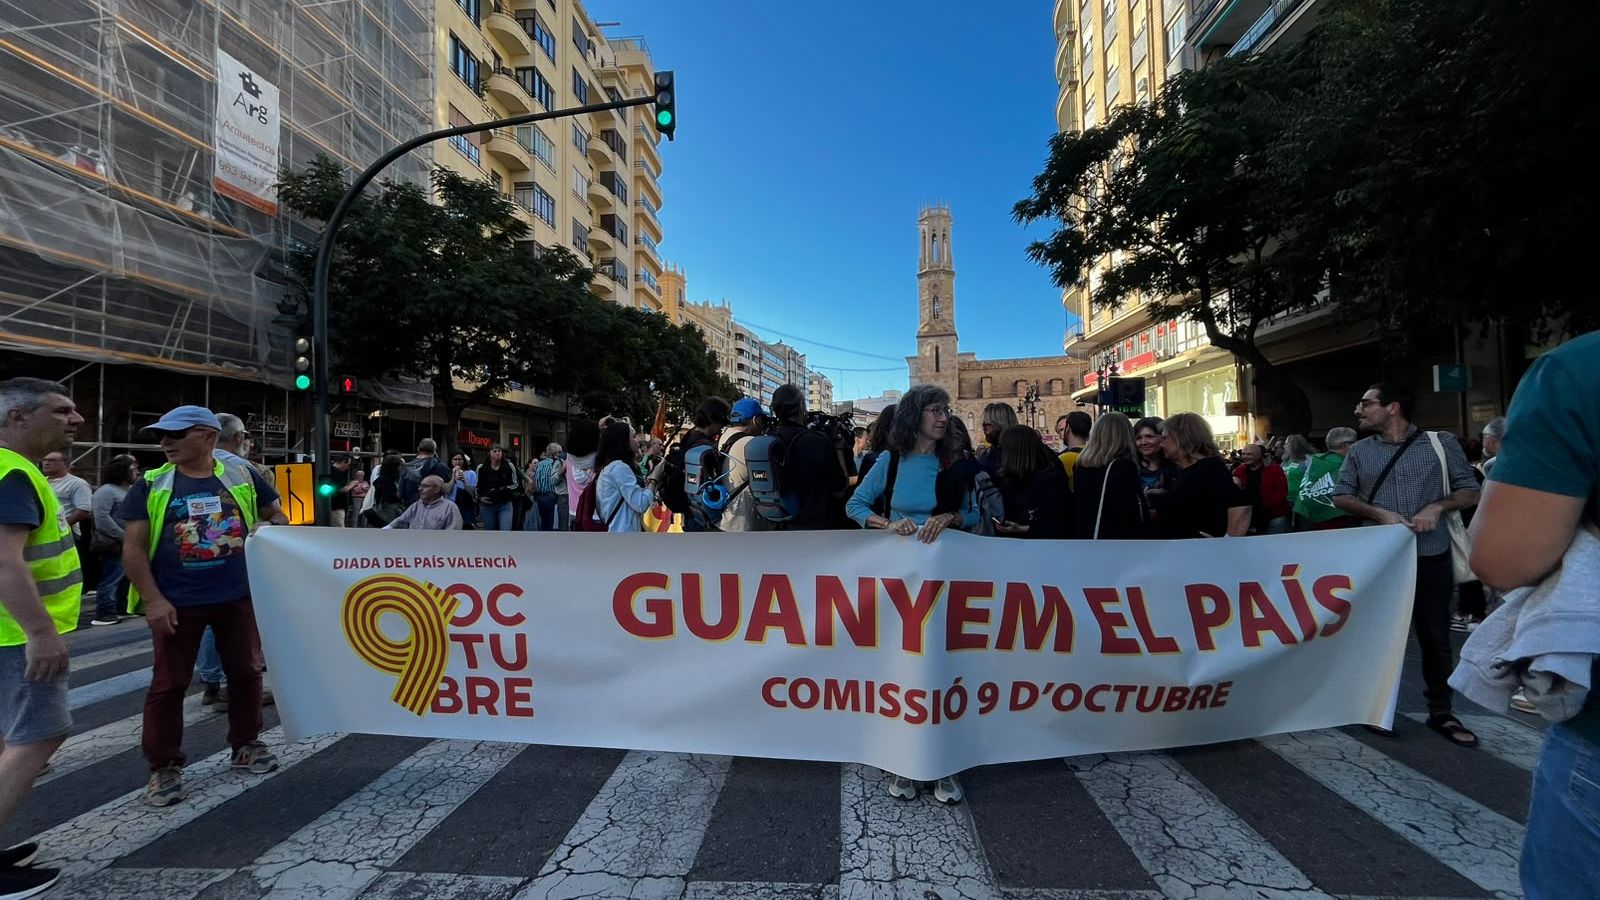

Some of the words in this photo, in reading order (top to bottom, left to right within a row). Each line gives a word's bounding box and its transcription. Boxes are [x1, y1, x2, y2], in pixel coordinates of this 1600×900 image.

[233, 92, 267, 124] Arg
[223, 120, 276, 156] Arquitectos
[333, 557, 381, 569] DIADA
[384, 557, 411, 568] DEL
[414, 555, 444, 568] PAÍS
[447, 555, 518, 568] VALENCIÀ
[612, 571, 1075, 656] GUANYEM
[1082, 586, 1182, 656] EL
[1184, 563, 1353, 652] PAÍS
[761, 676, 968, 725] COMISSIÓ
[977, 681, 1000, 715] 9
[1009, 680, 1233, 713] D'OCTUBRE
